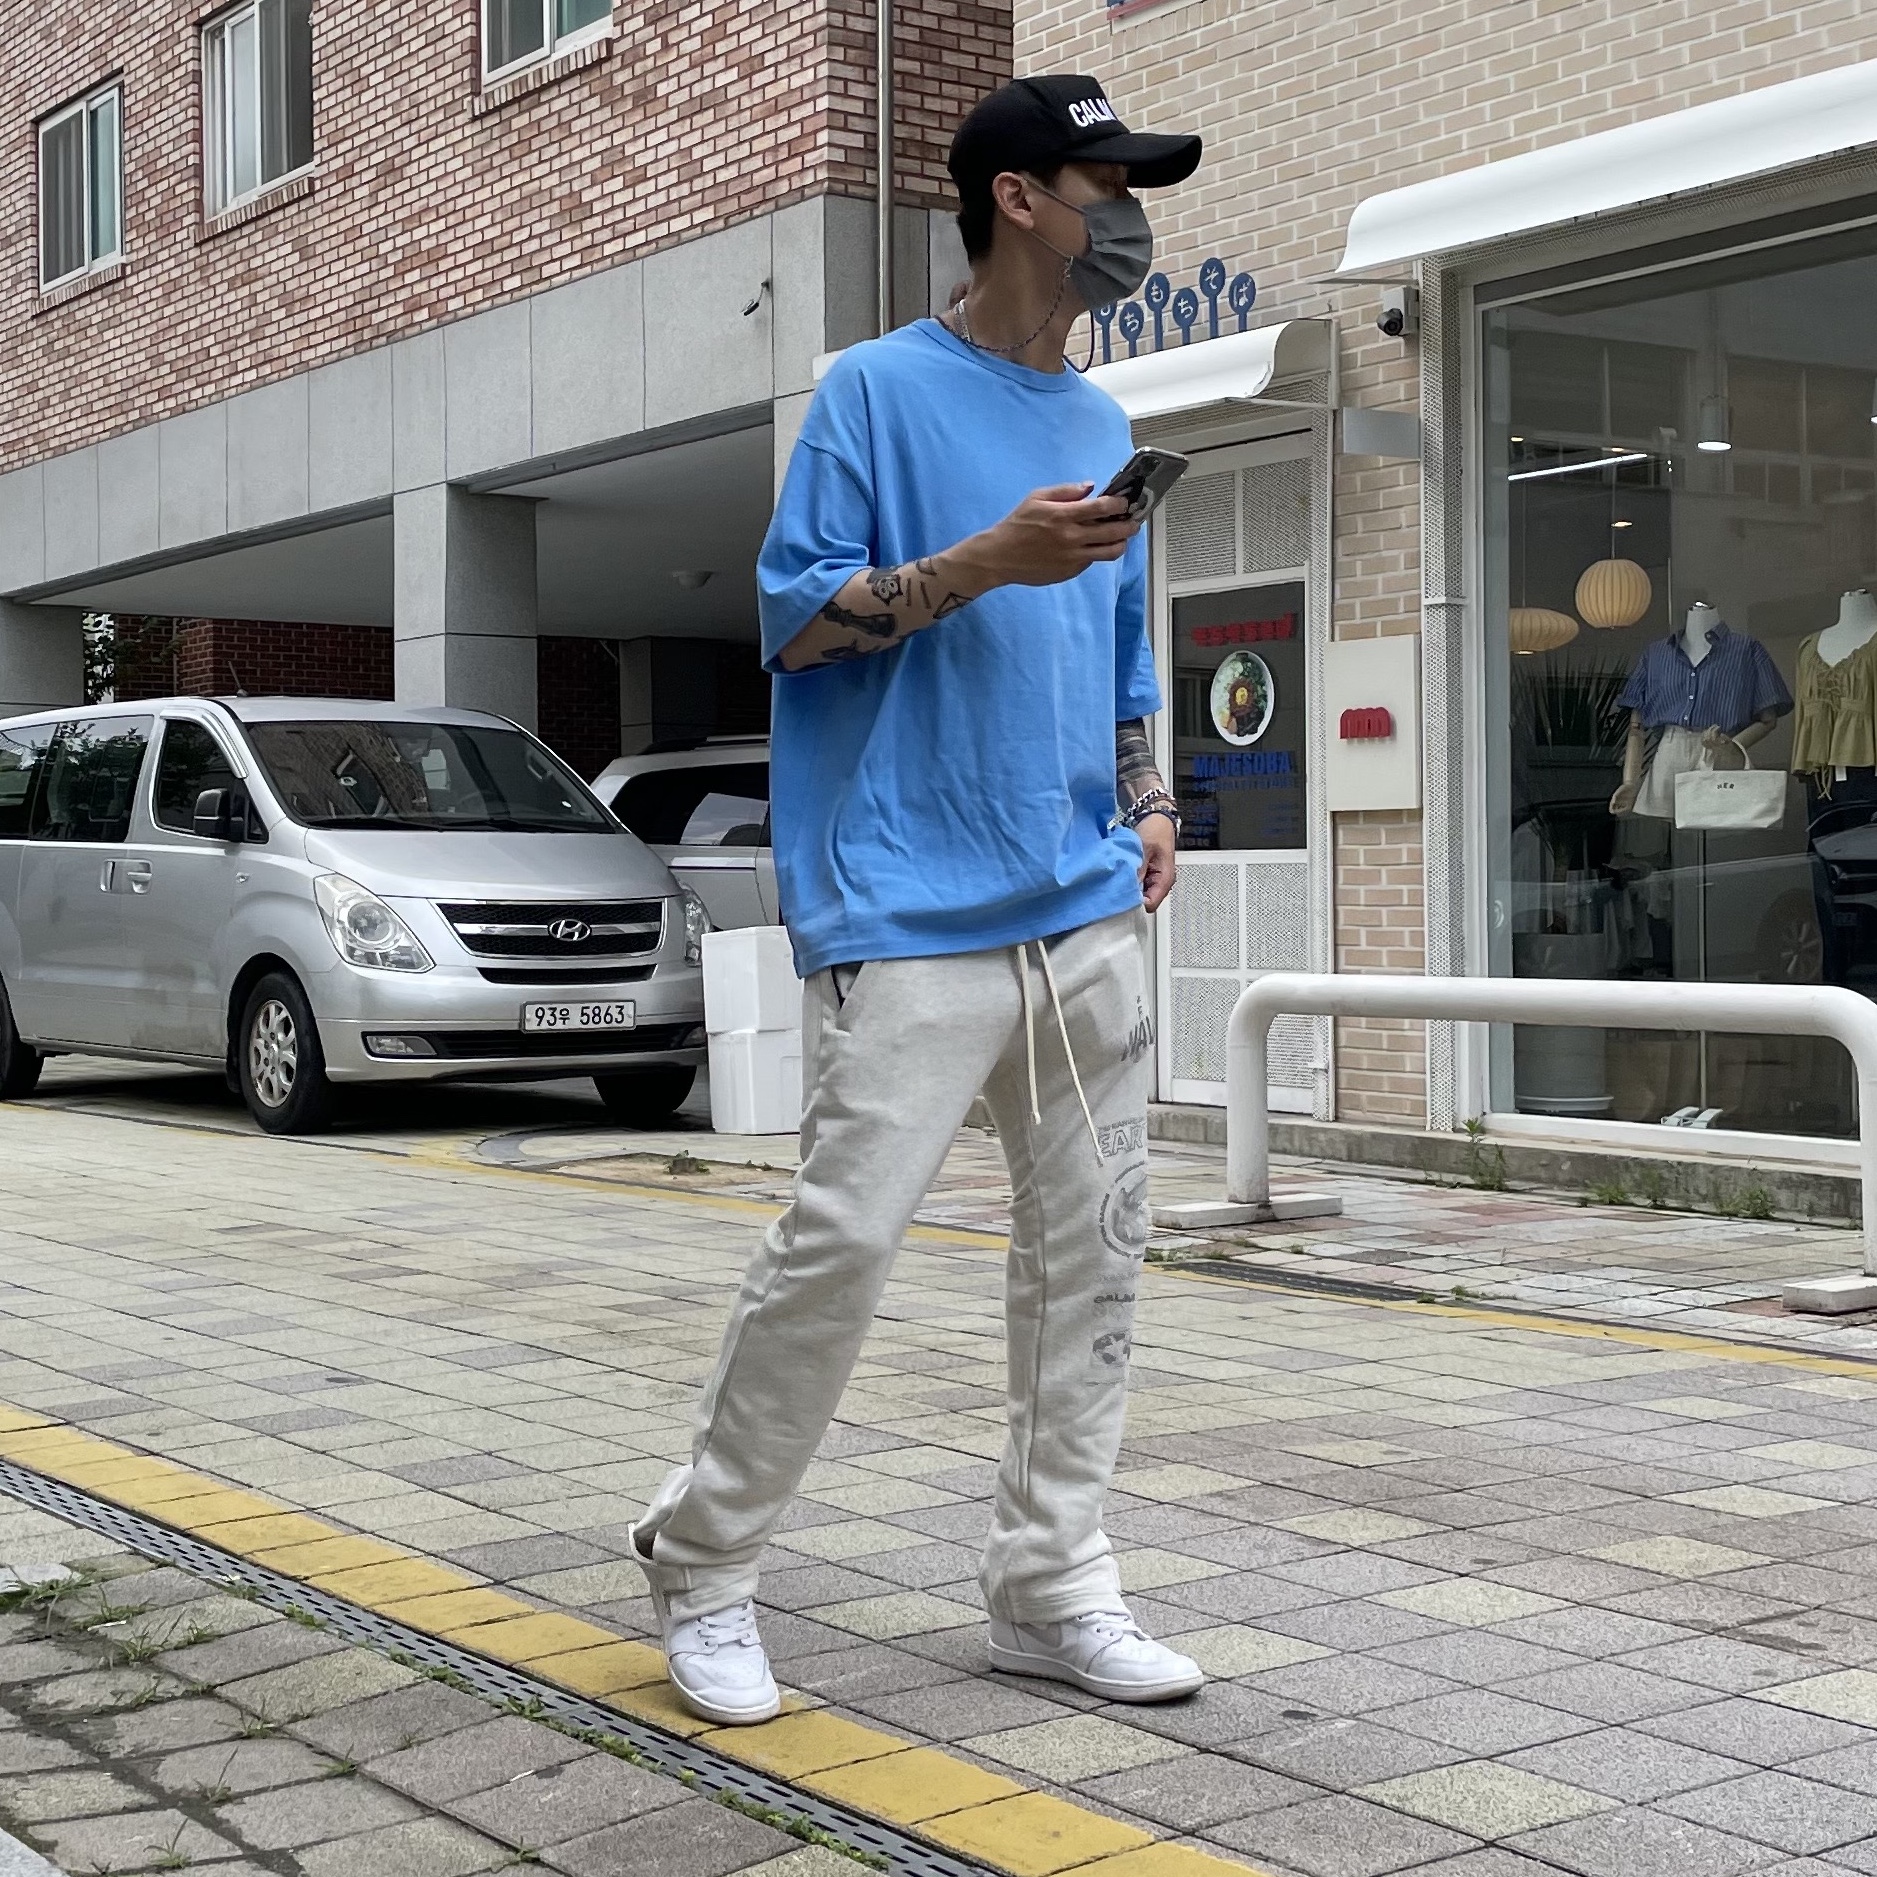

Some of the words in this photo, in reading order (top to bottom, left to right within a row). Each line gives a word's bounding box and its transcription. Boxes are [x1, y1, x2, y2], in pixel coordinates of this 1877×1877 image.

[534, 1006, 571, 1027] 93우
[579, 1004, 626, 1026] 5863
[1098, 1122, 1147, 1158] EAR
